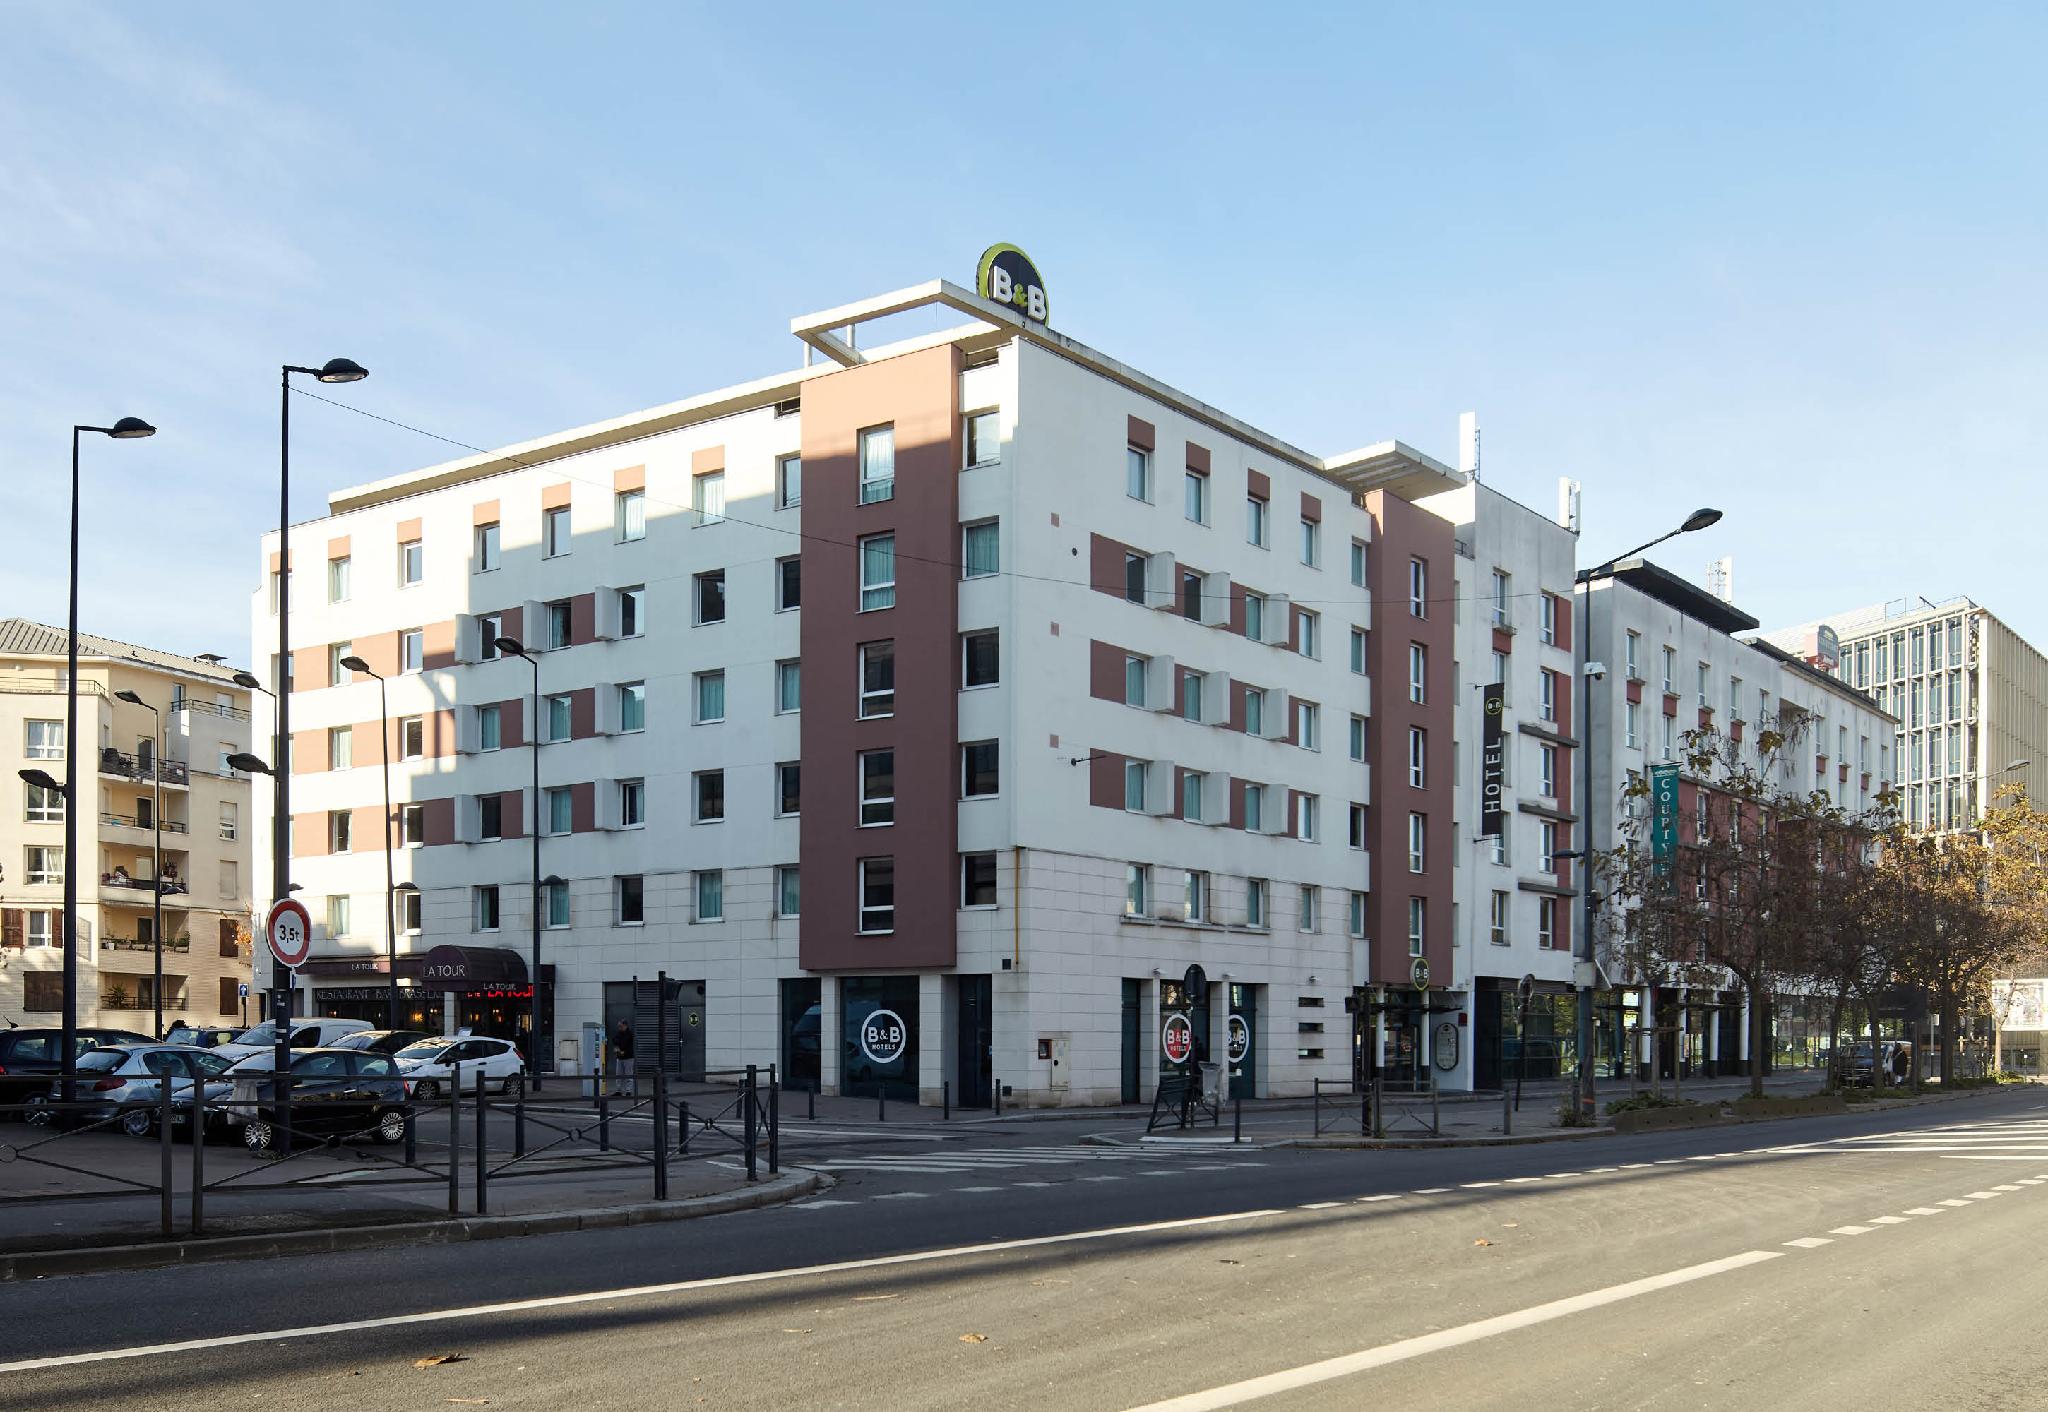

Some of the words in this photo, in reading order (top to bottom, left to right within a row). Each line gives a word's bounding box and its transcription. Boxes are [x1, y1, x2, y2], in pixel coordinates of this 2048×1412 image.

[993, 265, 1047, 321] B&B
[1484, 737, 1501, 813] HOTEL
[279, 924, 300, 943] 3,5t
[423, 966, 436, 978] LA
[436, 964, 465, 977] TOUR
[316, 988, 369, 1000] RESTAURANT
[496, 983, 517, 991] TOUR
[867, 1026, 901, 1043] B&B
[1167, 1029, 1190, 1044] B&B
